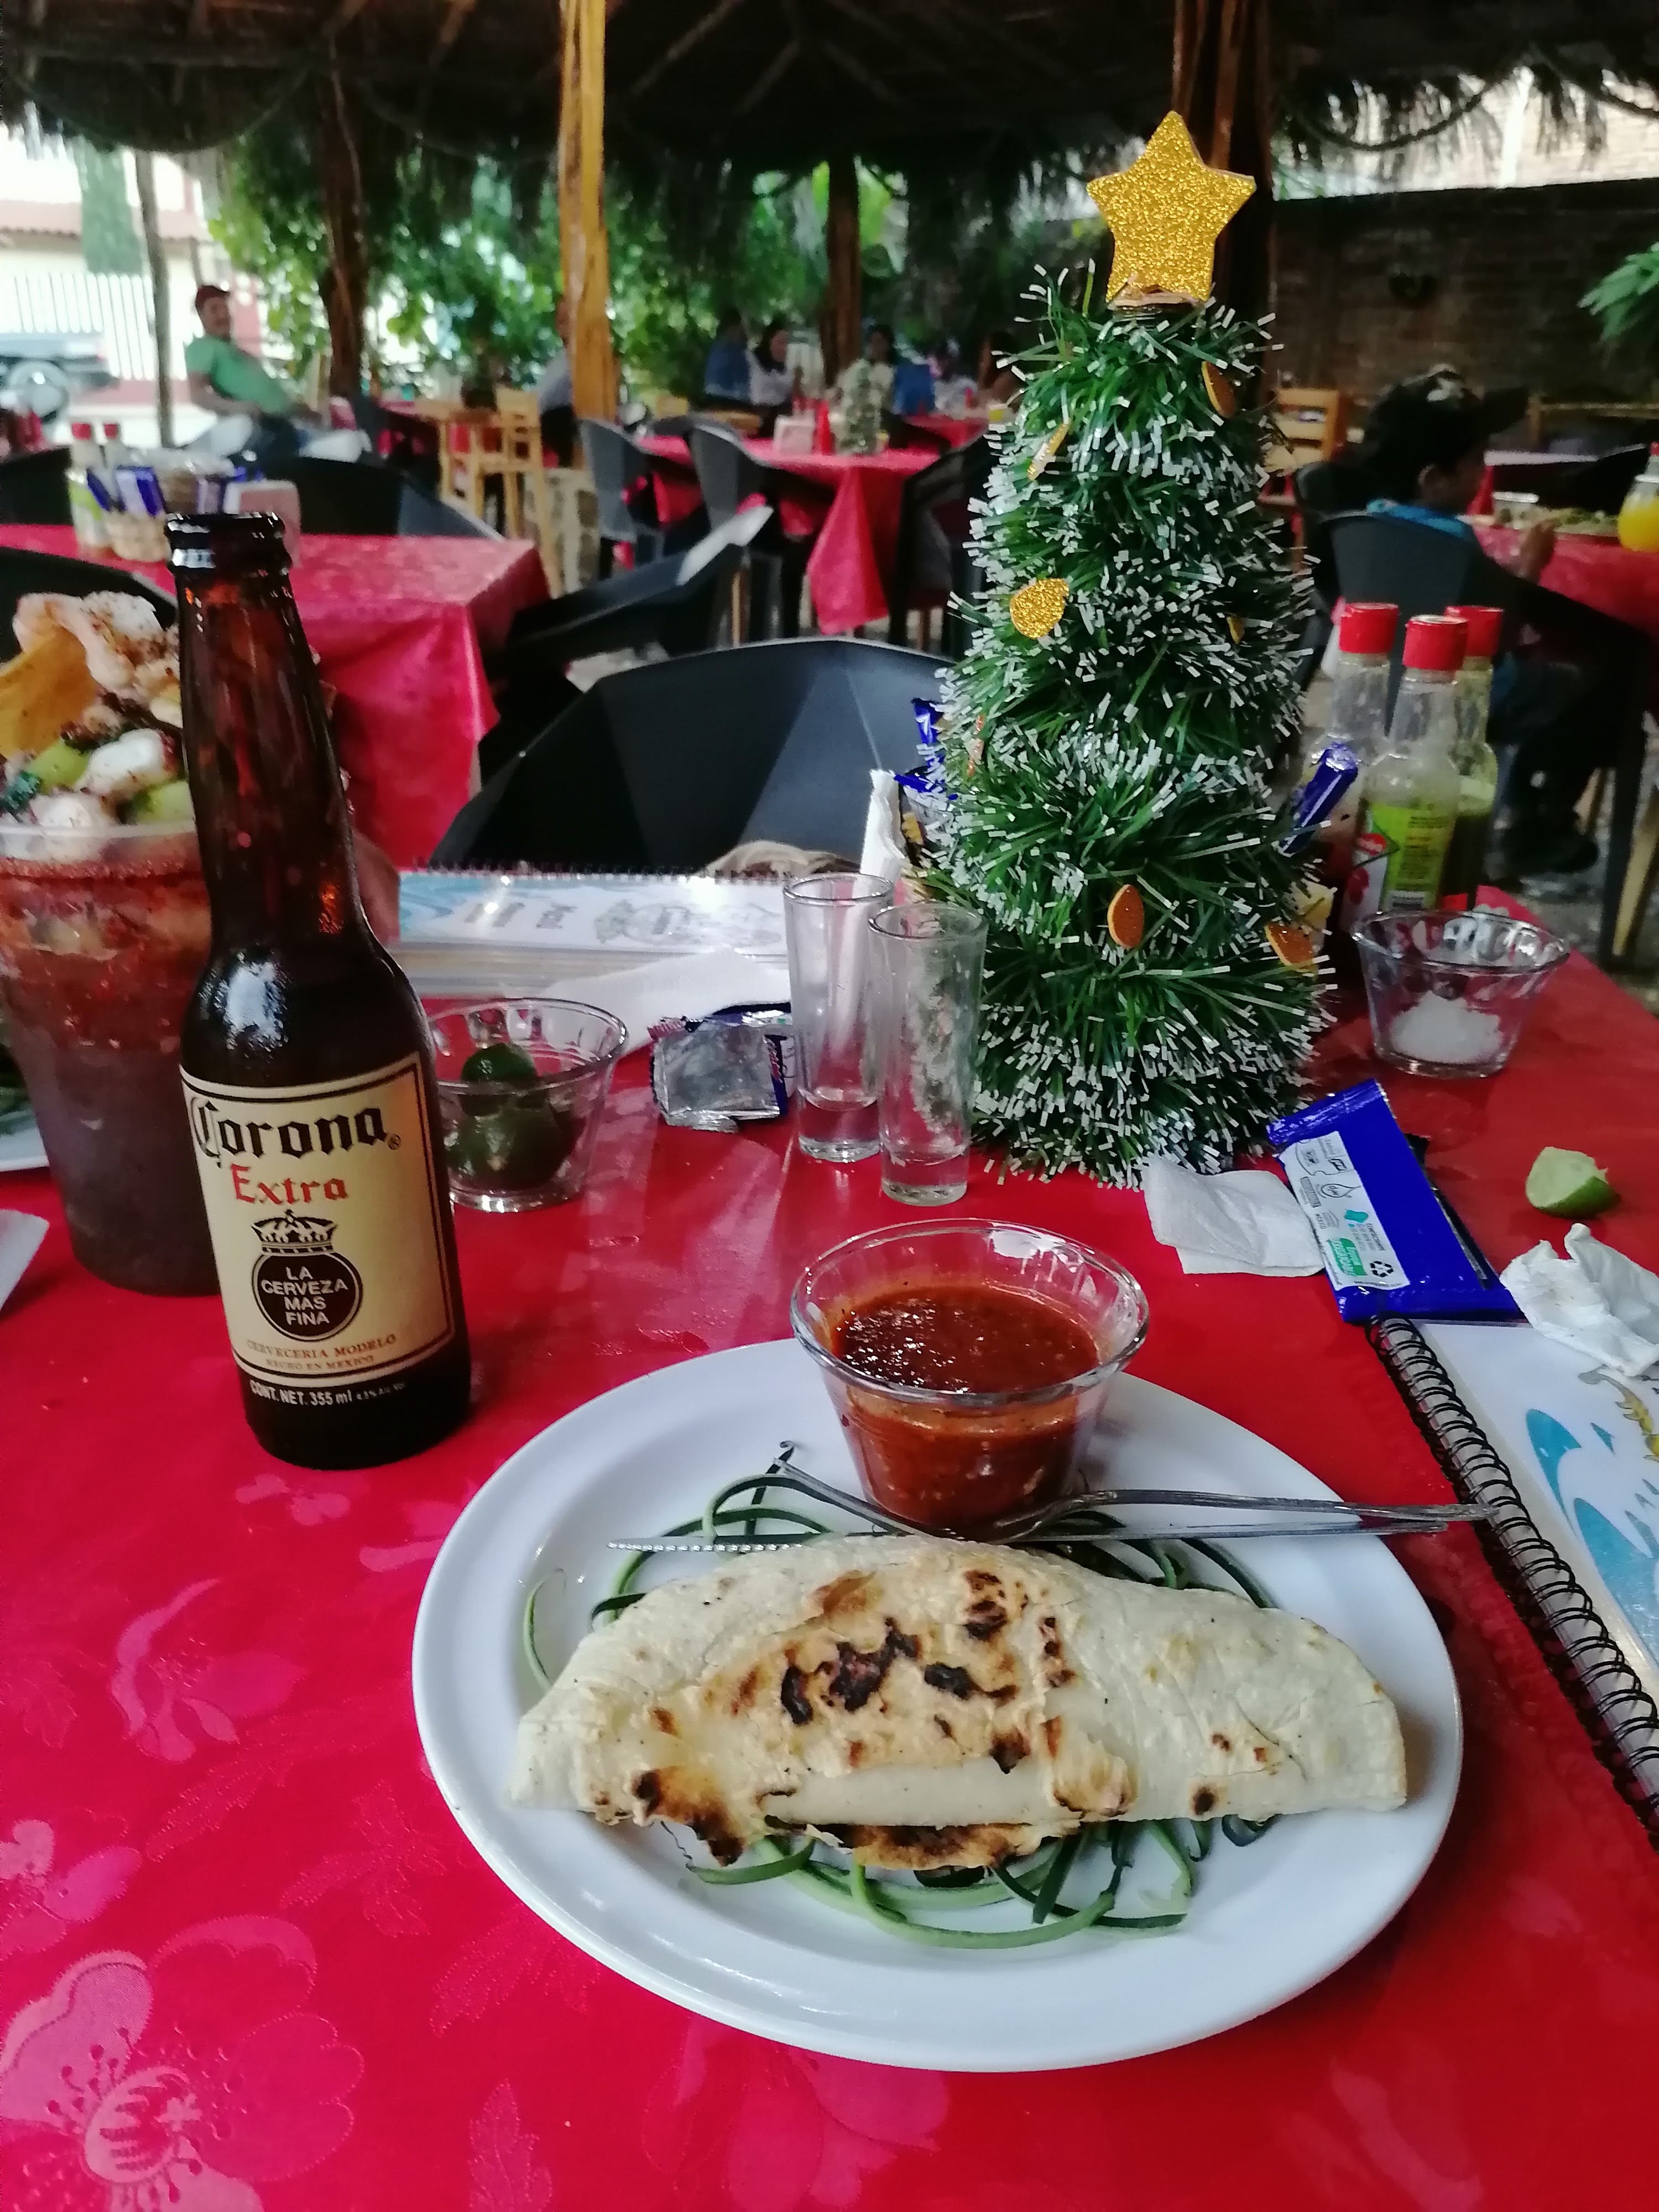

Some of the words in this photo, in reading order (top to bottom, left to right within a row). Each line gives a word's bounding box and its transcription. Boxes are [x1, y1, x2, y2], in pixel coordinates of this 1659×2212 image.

[191, 1097, 388, 1168] Corona
[230, 1163, 349, 1204] Extra
[285, 1266, 313, 1281] LA
[260, 1278, 349, 1296] CERVEZA
[284, 1296, 327, 1311] MAS
[285, 1311, 330, 1326] FINA
[333, 1333, 397, 1357] MODELO
[311, 1391, 334, 1406] 355
[336, 1389, 353, 1405] ml
